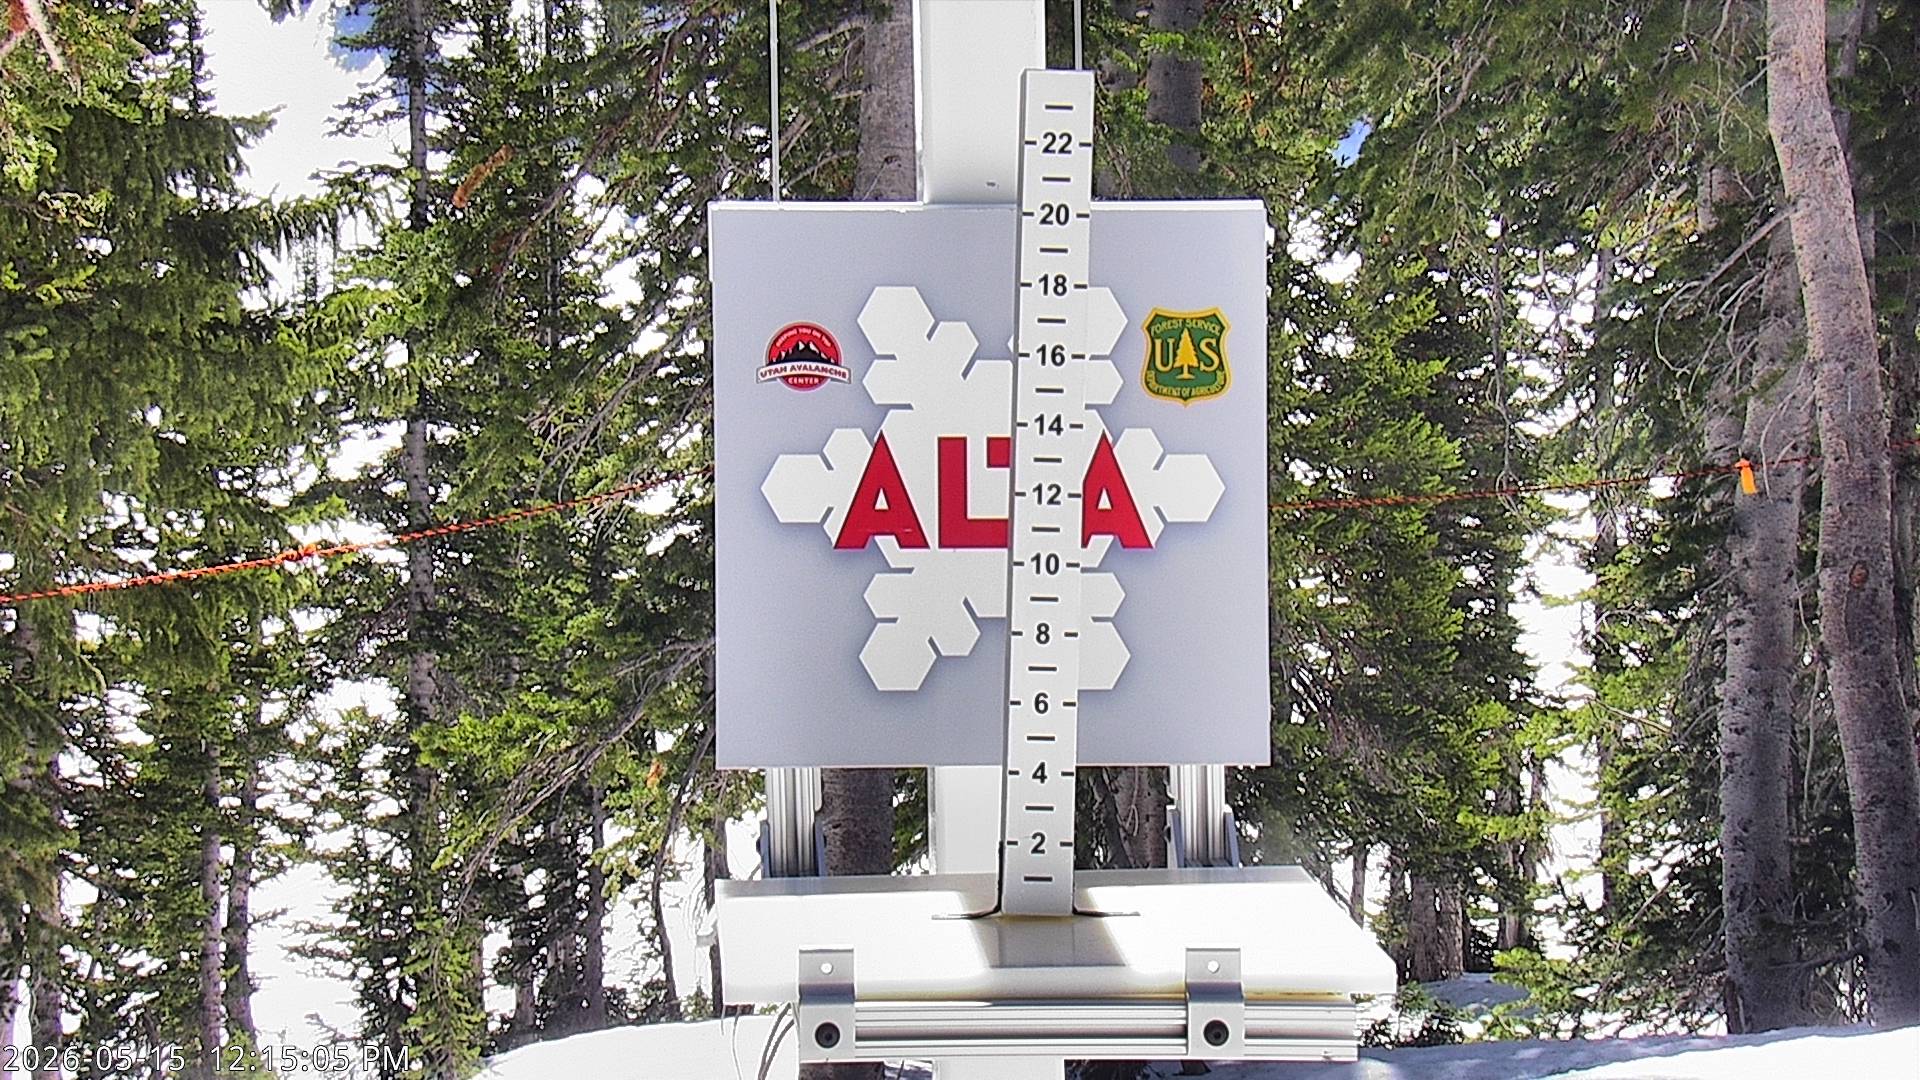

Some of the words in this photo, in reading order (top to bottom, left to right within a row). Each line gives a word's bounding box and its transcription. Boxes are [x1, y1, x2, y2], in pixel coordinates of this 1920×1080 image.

[1042, 132, 1073, 155] 22
[1039, 203, 1070, 226] 20
[1039, 274, 1067, 297] 18
[1038, 344, 1067, 367] 16
[760, 365, 787, 379] UTAH
[789, 363, 848, 379] AVALANCHE
[788, 376, 820, 385] CENTER
[1034, 414, 1064, 436] 14
[834, 430, 1154, 549] ALA
[1032, 483, 1062, 506] 12
[1030, 553, 1060, 575] 10
[1035, 622, 1050, 645] 8
[1034, 692, 1049, 714] 6
[1031, 762, 1048, 784] 4
[1030, 832, 1046, 855] 2
